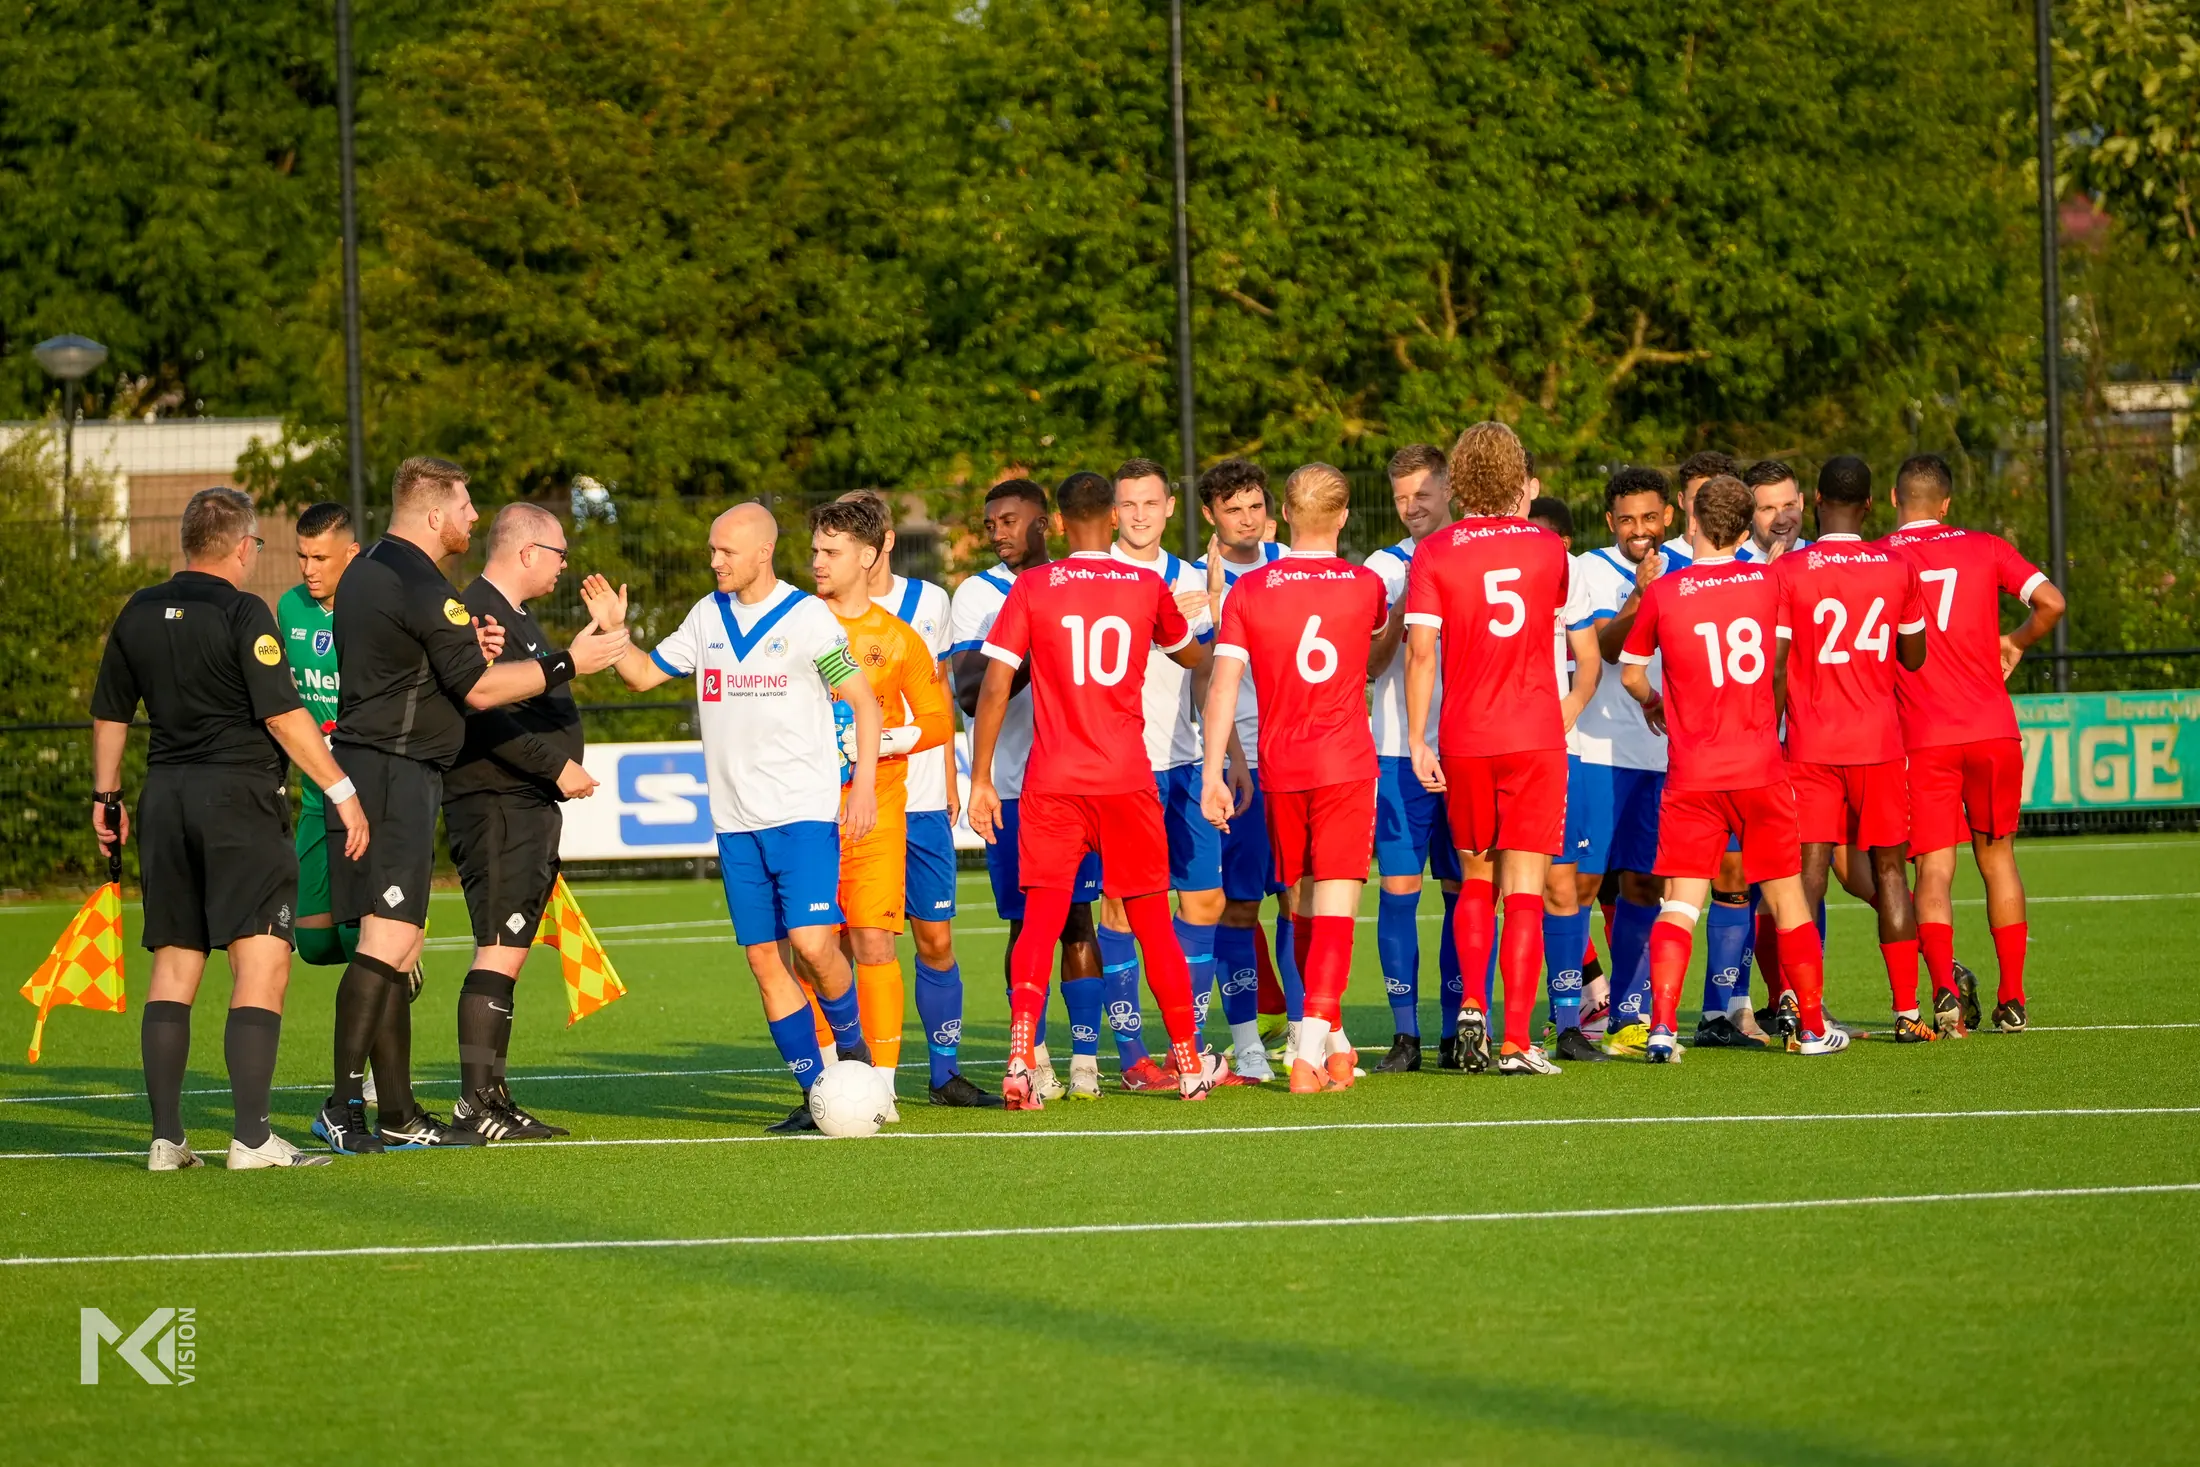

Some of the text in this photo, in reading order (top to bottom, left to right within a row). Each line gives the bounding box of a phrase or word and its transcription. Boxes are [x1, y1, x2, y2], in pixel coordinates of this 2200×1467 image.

[1824, 552, 1888, 563] vdv-vh.nl
[1067, 568, 1140, 581] vdv-vh.nl
[1283, 569, 1356, 581] vdv-vh.nl
[1696, 570, 1764, 588] vdv-vh.nl
[1483, 567, 1526, 638] 5
[1919, 567, 1958, 632] 7
[1813, 596, 1890, 665] 24
[258, 645, 279, 656] ARAG
[708, 642, 725, 650] JAKO
[1061, 614, 1132, 687] 10
[1296, 614, 1338, 684] 6
[1693, 616, 1765, 688] 18
[726, 674, 788, 689] RUMPING
[809, 902, 830, 912] JAKO
